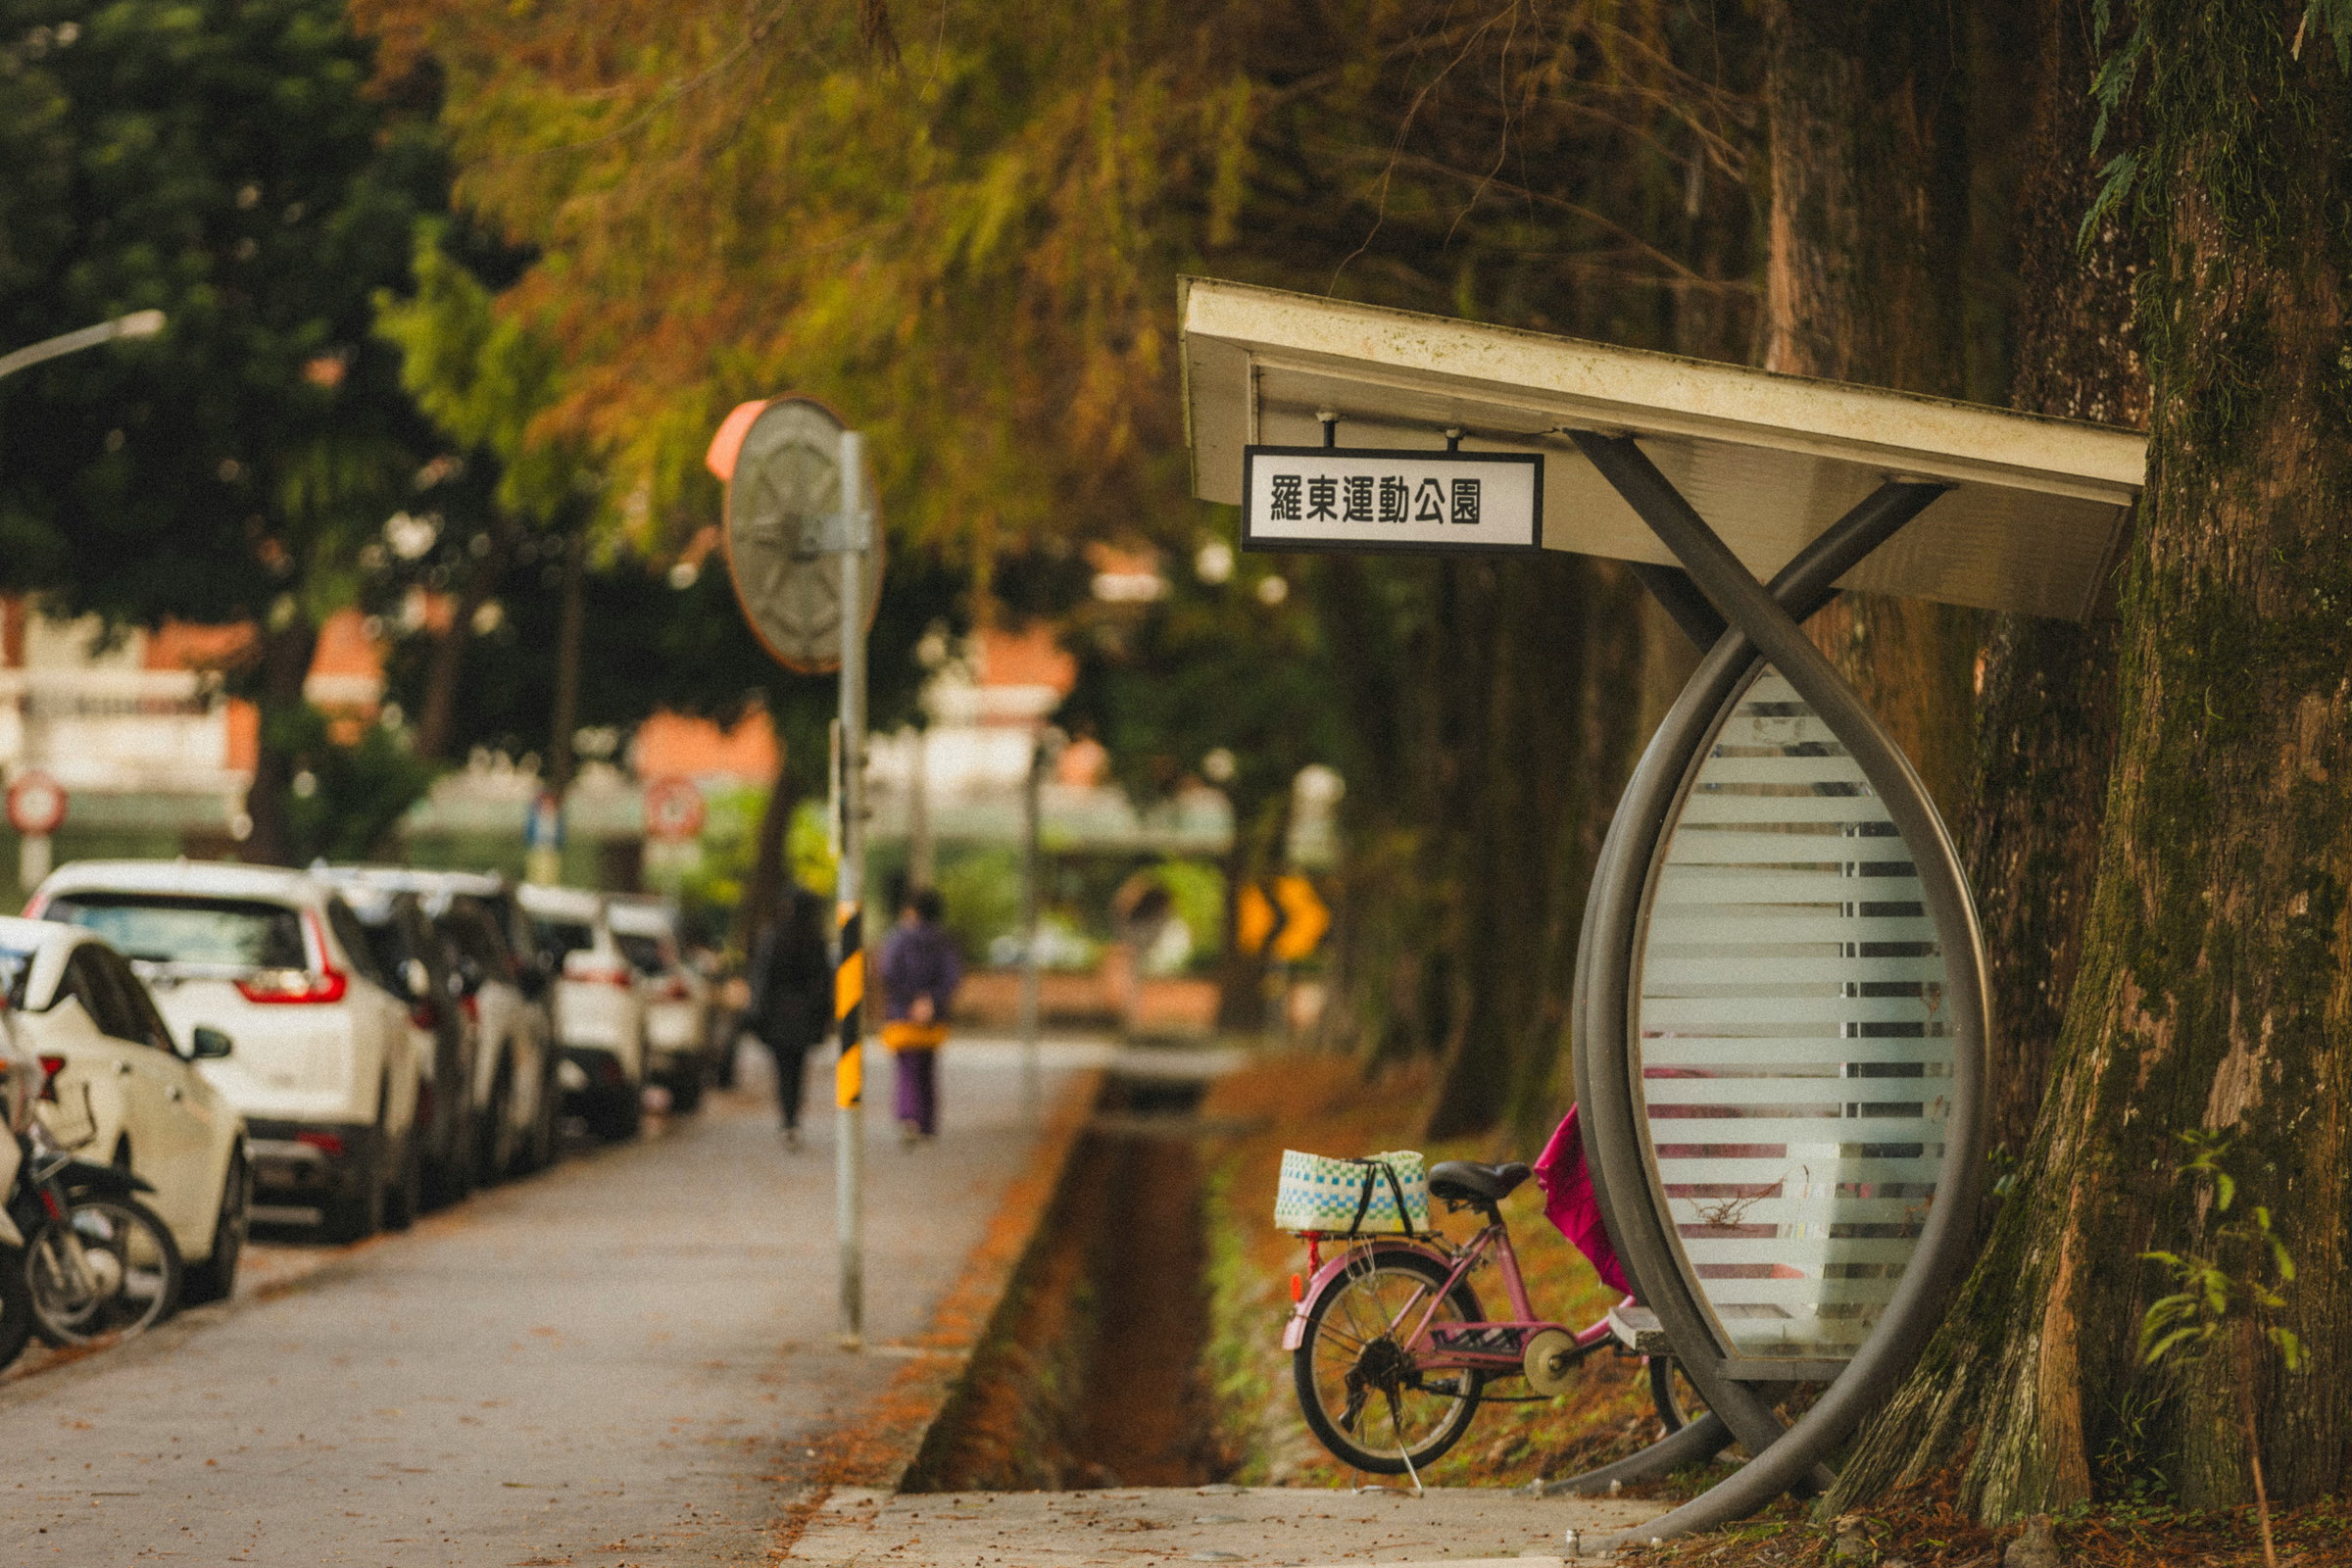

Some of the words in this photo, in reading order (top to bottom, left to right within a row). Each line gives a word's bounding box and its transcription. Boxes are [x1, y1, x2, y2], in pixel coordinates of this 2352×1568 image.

[1270, 474, 1481, 524] 羅東運動公園
